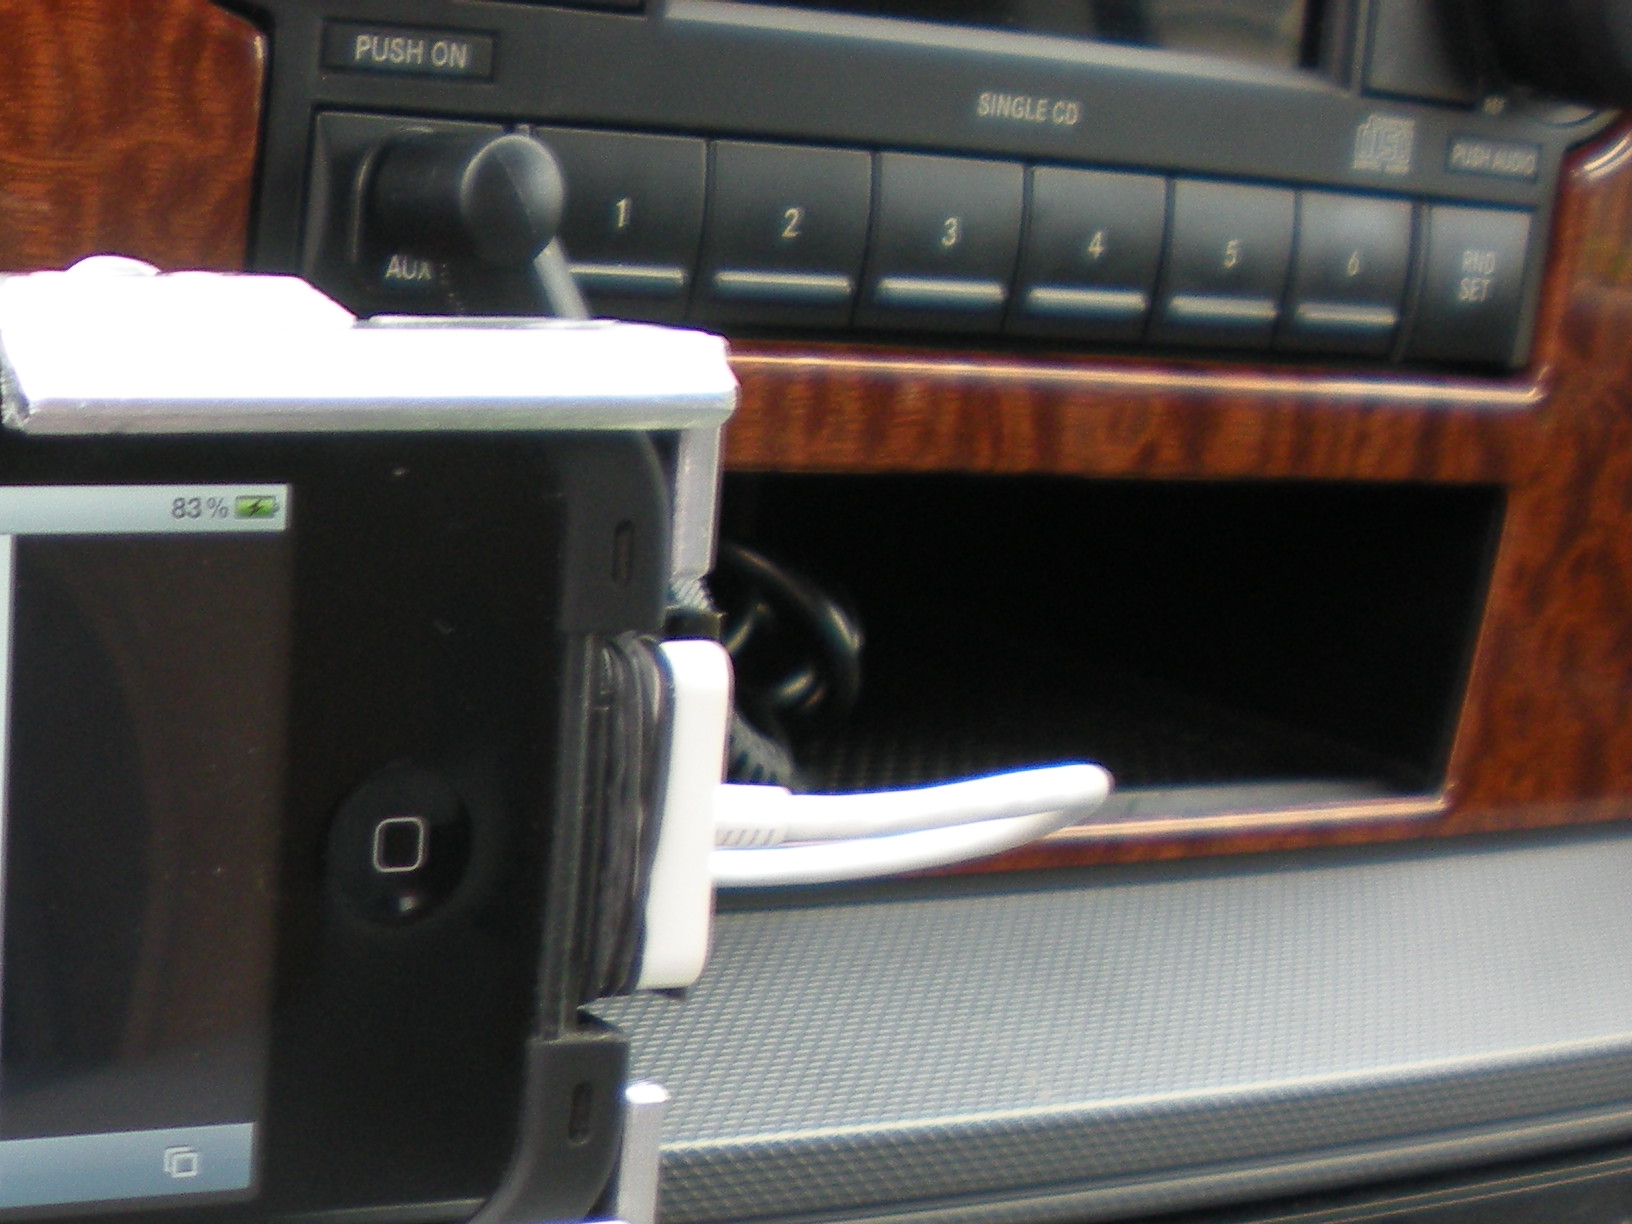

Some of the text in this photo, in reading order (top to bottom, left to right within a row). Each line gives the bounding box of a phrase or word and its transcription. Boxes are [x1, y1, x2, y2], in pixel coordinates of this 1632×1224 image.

[354, 34, 468, 68] PUSH ON
[977, 91, 1081, 125] SINGLE CD
[615, 197, 632, 230] 1
[782, 206, 804, 239] 2
[942, 216, 960, 248] 3
[1087, 230, 1105, 260] 4
[385, 254, 432, 281] AUX
[1223, 239, 1240, 269] 5
[1346, 250, 1361, 277] 6
[172, 497, 229, 519] 83%
